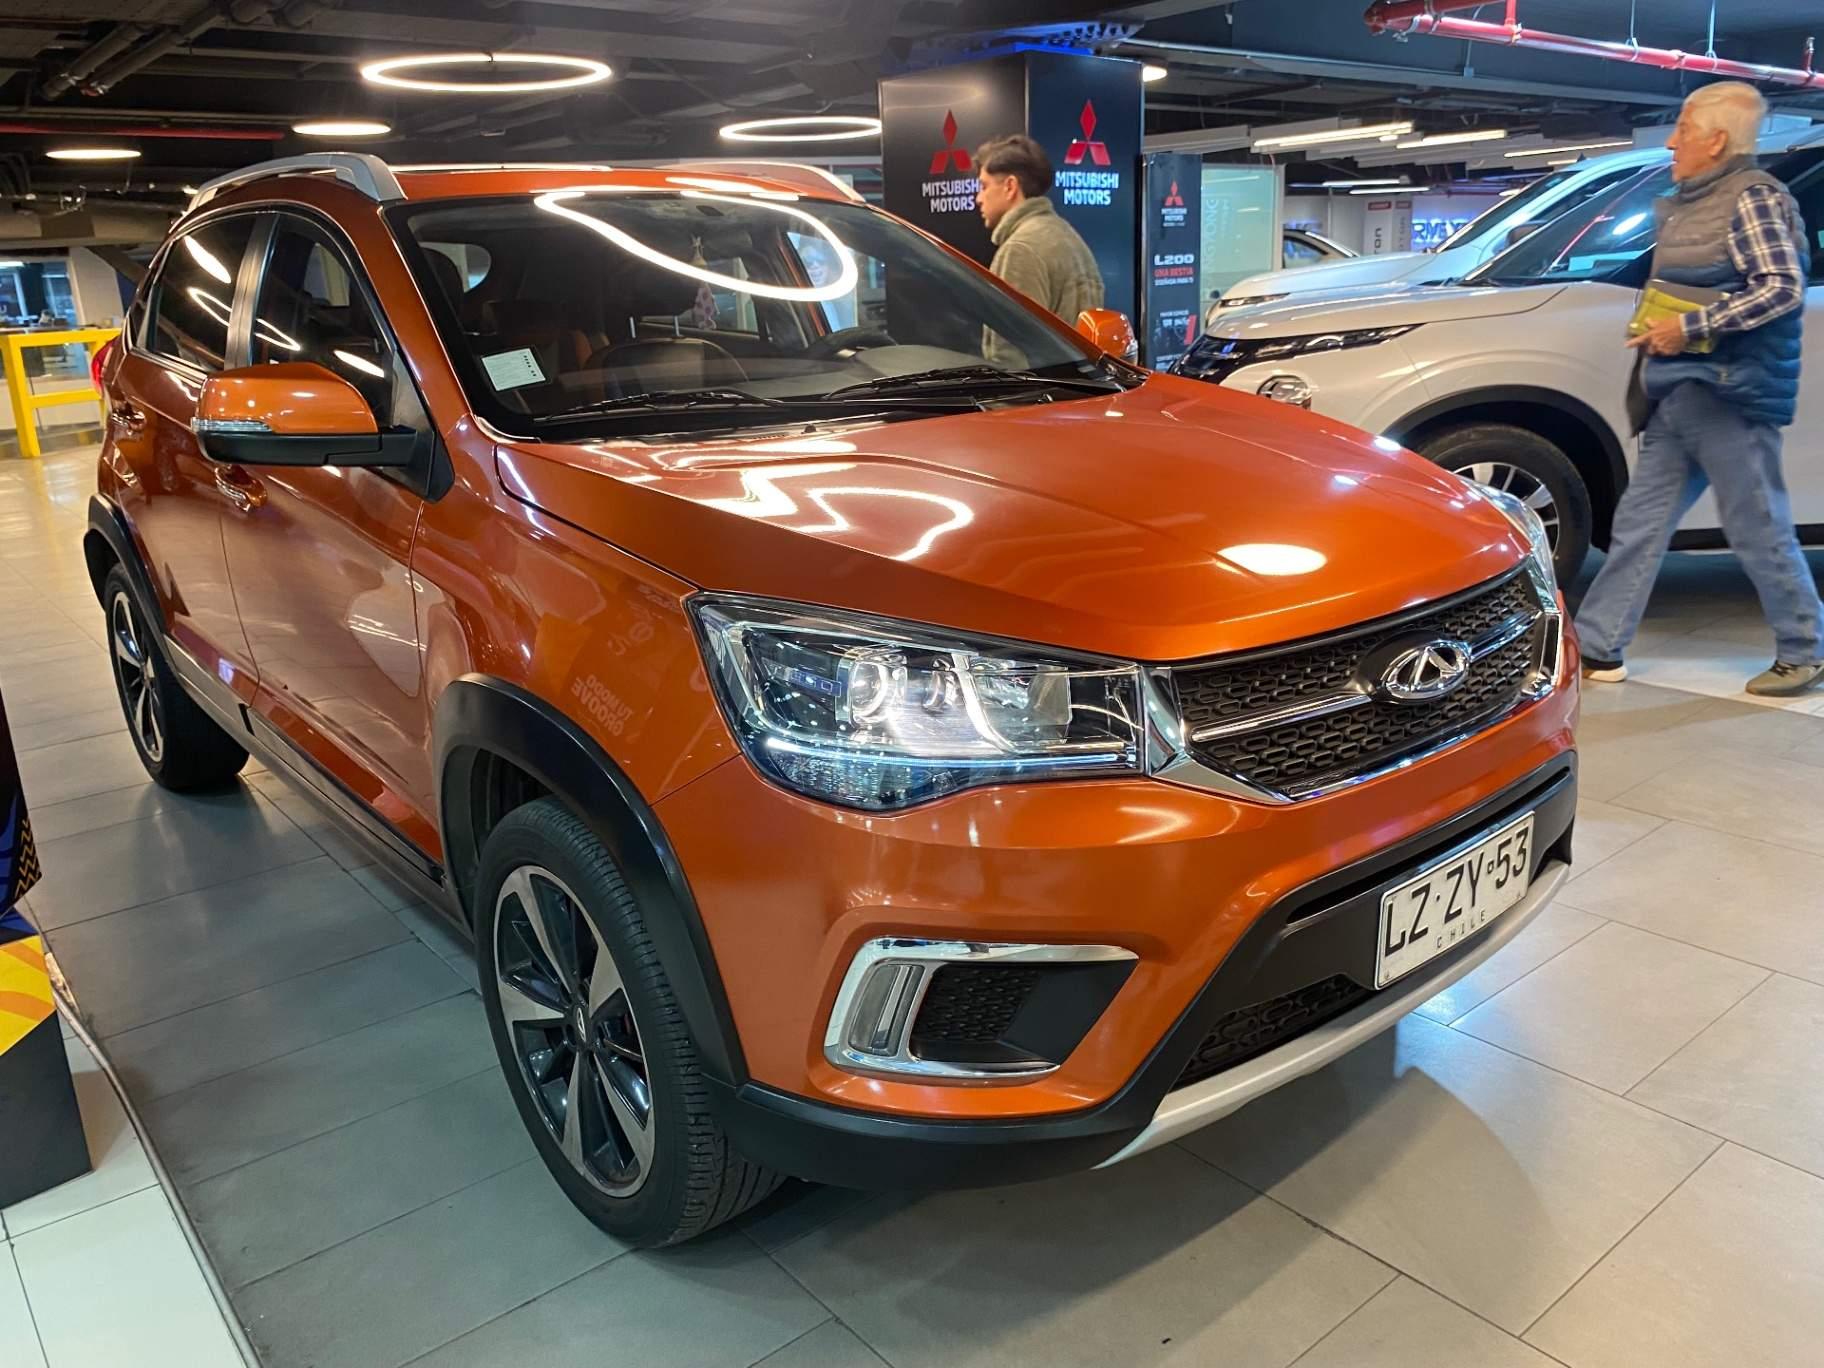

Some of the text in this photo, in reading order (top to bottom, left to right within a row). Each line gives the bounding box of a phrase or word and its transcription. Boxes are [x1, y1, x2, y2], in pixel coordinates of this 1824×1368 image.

[1055, 171, 1119, 189] MITSUBISHI
[930, 196, 976, 213] MOTORS
[1063, 189, 1112, 205] MOTORS
[1154, 254, 1194, 265] L200
[1436, 910, 1486, 949] CHILE
